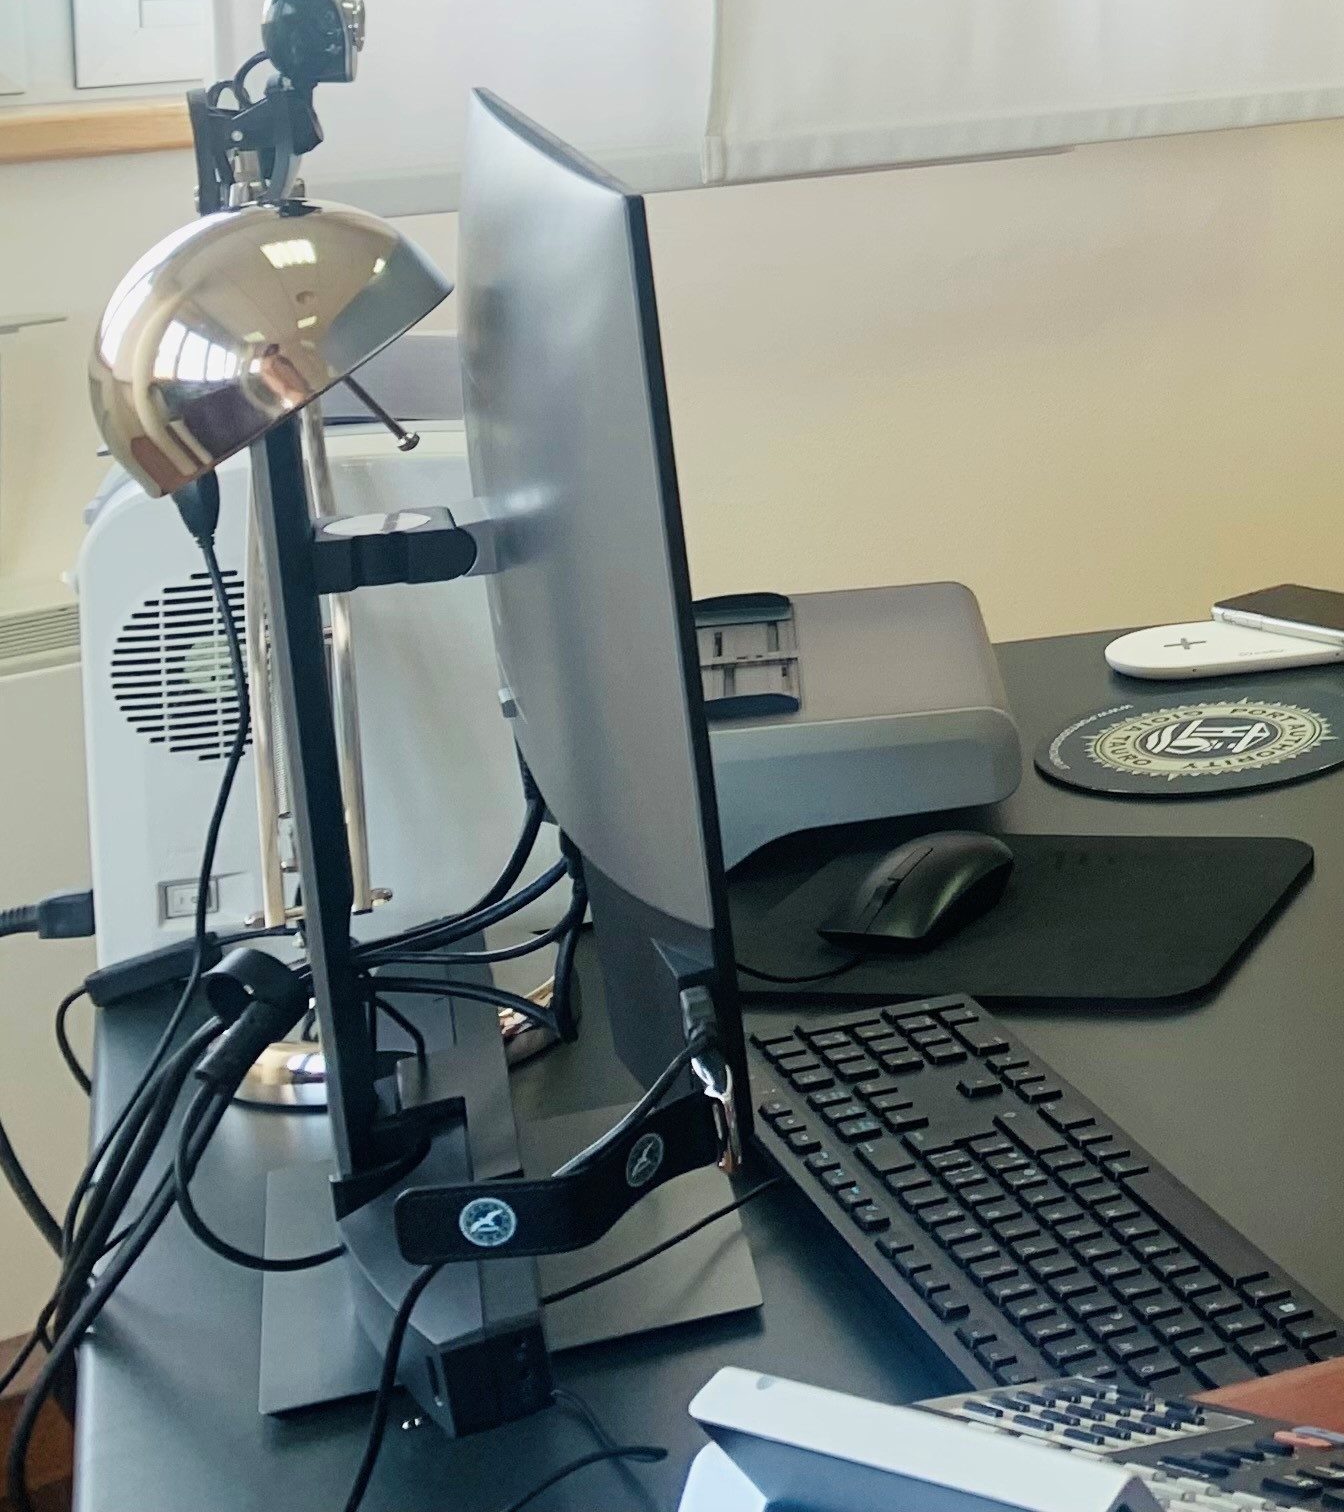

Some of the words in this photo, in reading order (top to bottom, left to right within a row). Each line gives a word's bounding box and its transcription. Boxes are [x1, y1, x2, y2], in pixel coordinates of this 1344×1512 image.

[1230, 707, 1293, 724] PORT
[1107, 735, 1152, 767] TAURO
[1180, 722, 1304, 770] AUTHORITY
